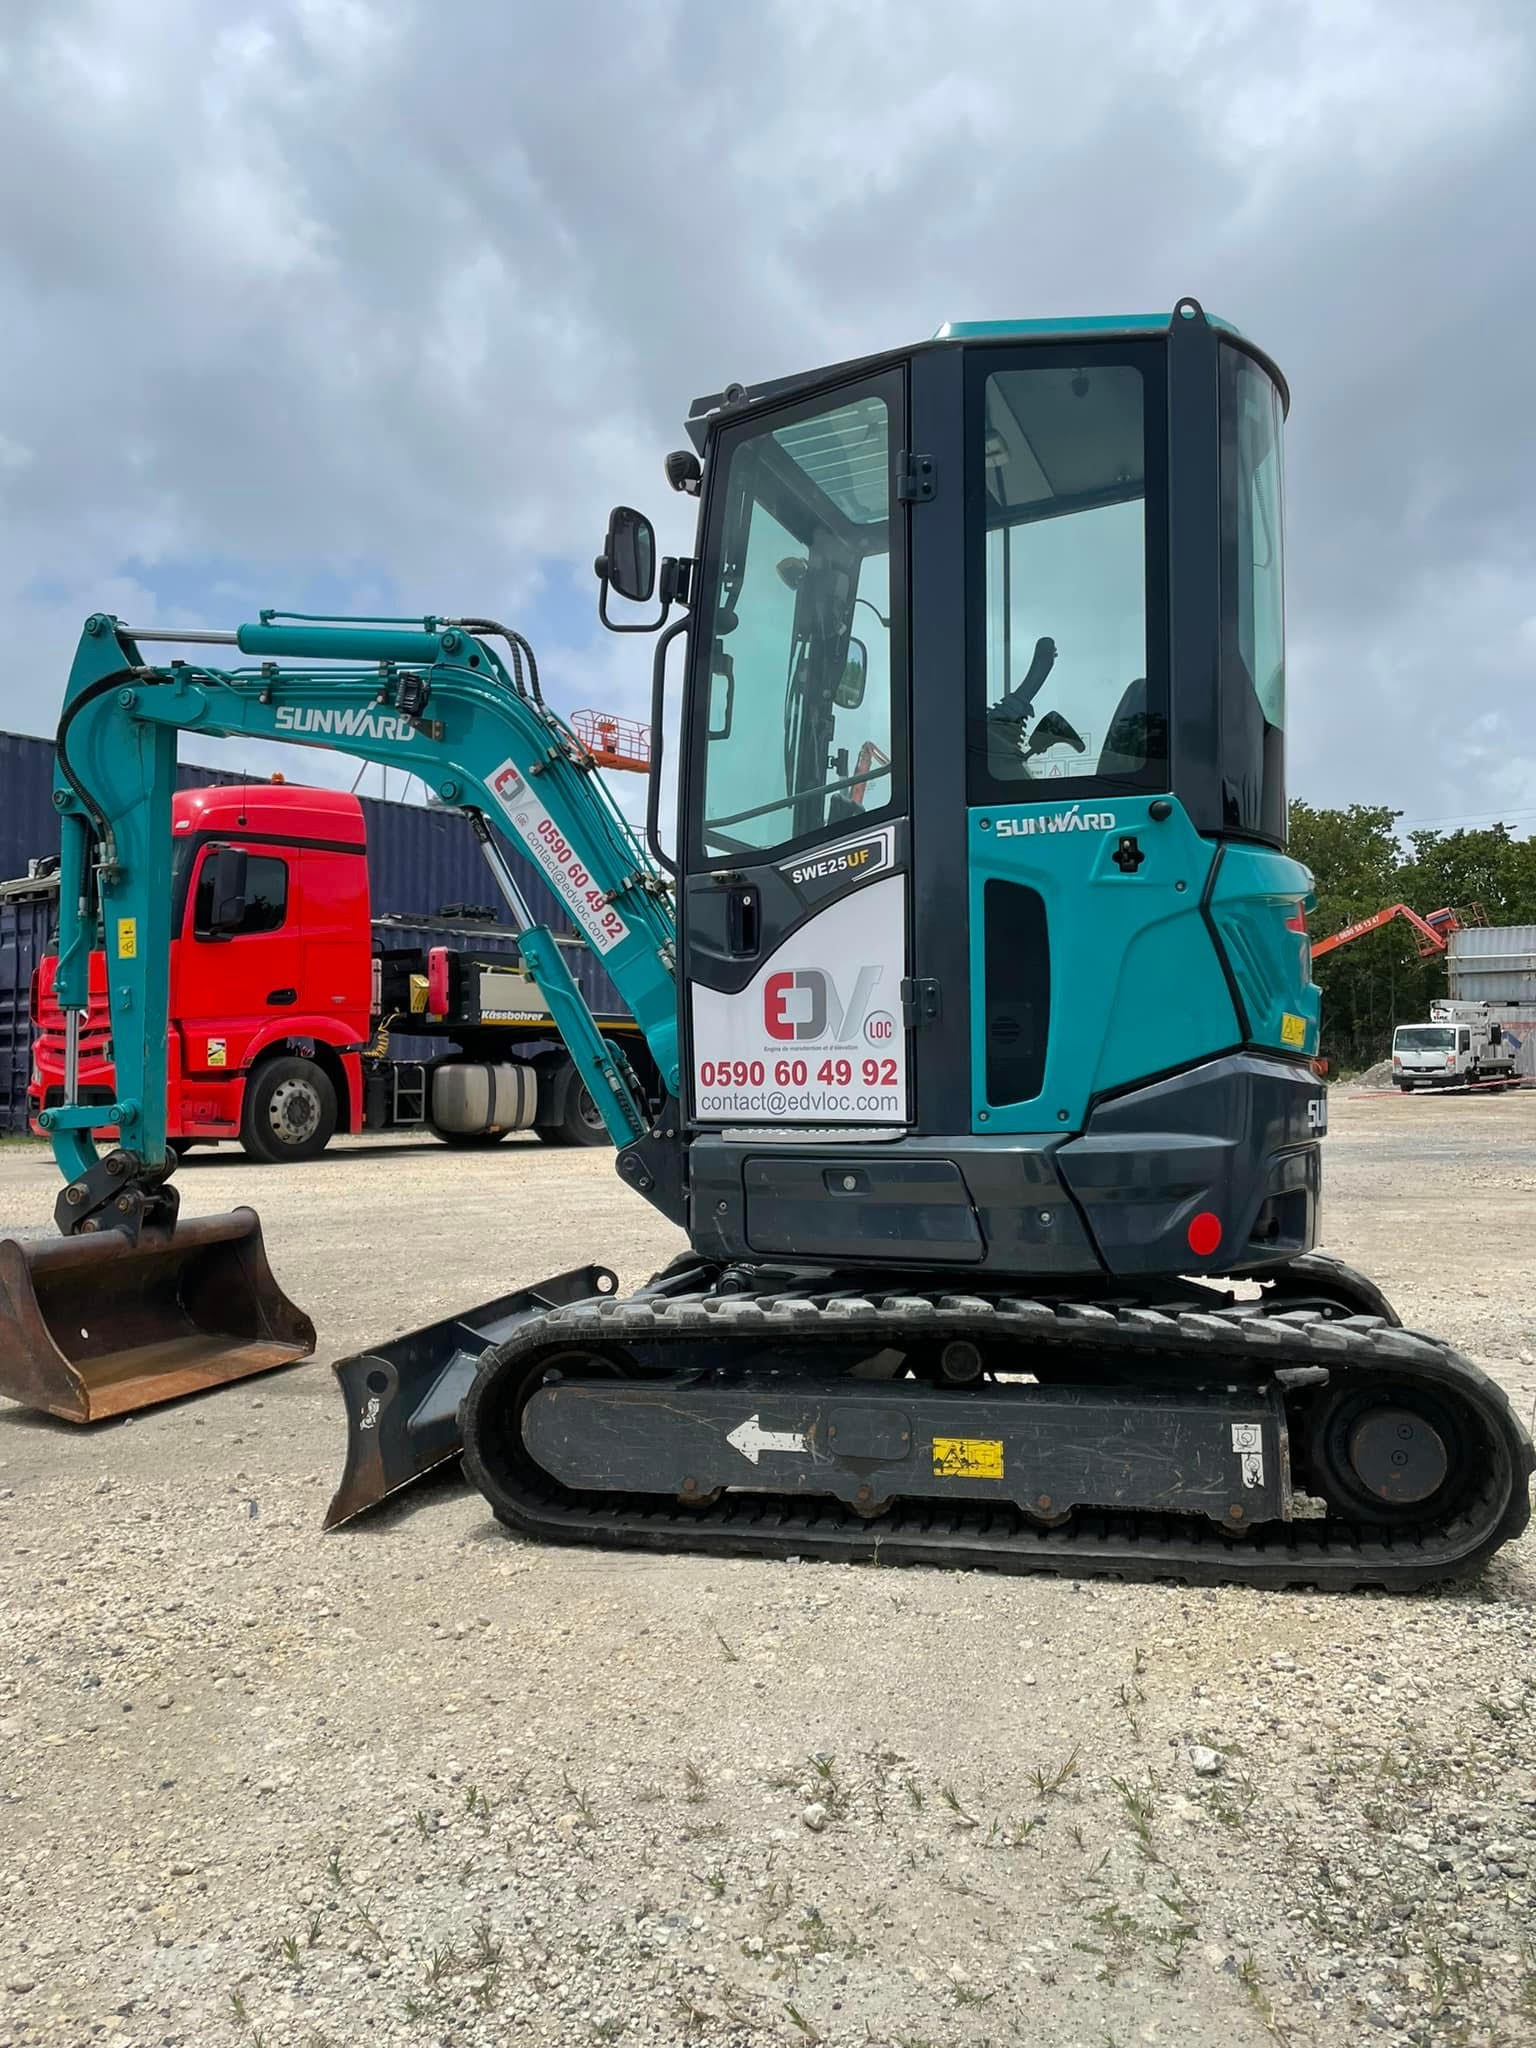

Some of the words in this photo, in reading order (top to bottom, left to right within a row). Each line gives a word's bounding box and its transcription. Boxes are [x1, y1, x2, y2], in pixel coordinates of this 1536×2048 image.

[274, 701, 416, 741] SUNWARD
[996, 804, 1116, 837] SUNWARD
[537, 819, 573, 864] 0590
[567, 863, 590, 889] 60
[585, 888, 606, 912] 49
[601, 911, 624, 938] 92
[792, 849, 869, 884] SWE25UF
[526, 831, 609, 947] contact@edvloc.com
[481, 1010, 543, 1021] Kässbohrer
[869, 1021, 892, 1039] LOC
[700, 1061, 765, 1087] 0590
[774, 1060, 808, 1086] 60
[817, 1059, 852, 1086] 49
[862, 1059, 898, 1086] 92
[701, 1091, 898, 1115] contact@edvloc.com
